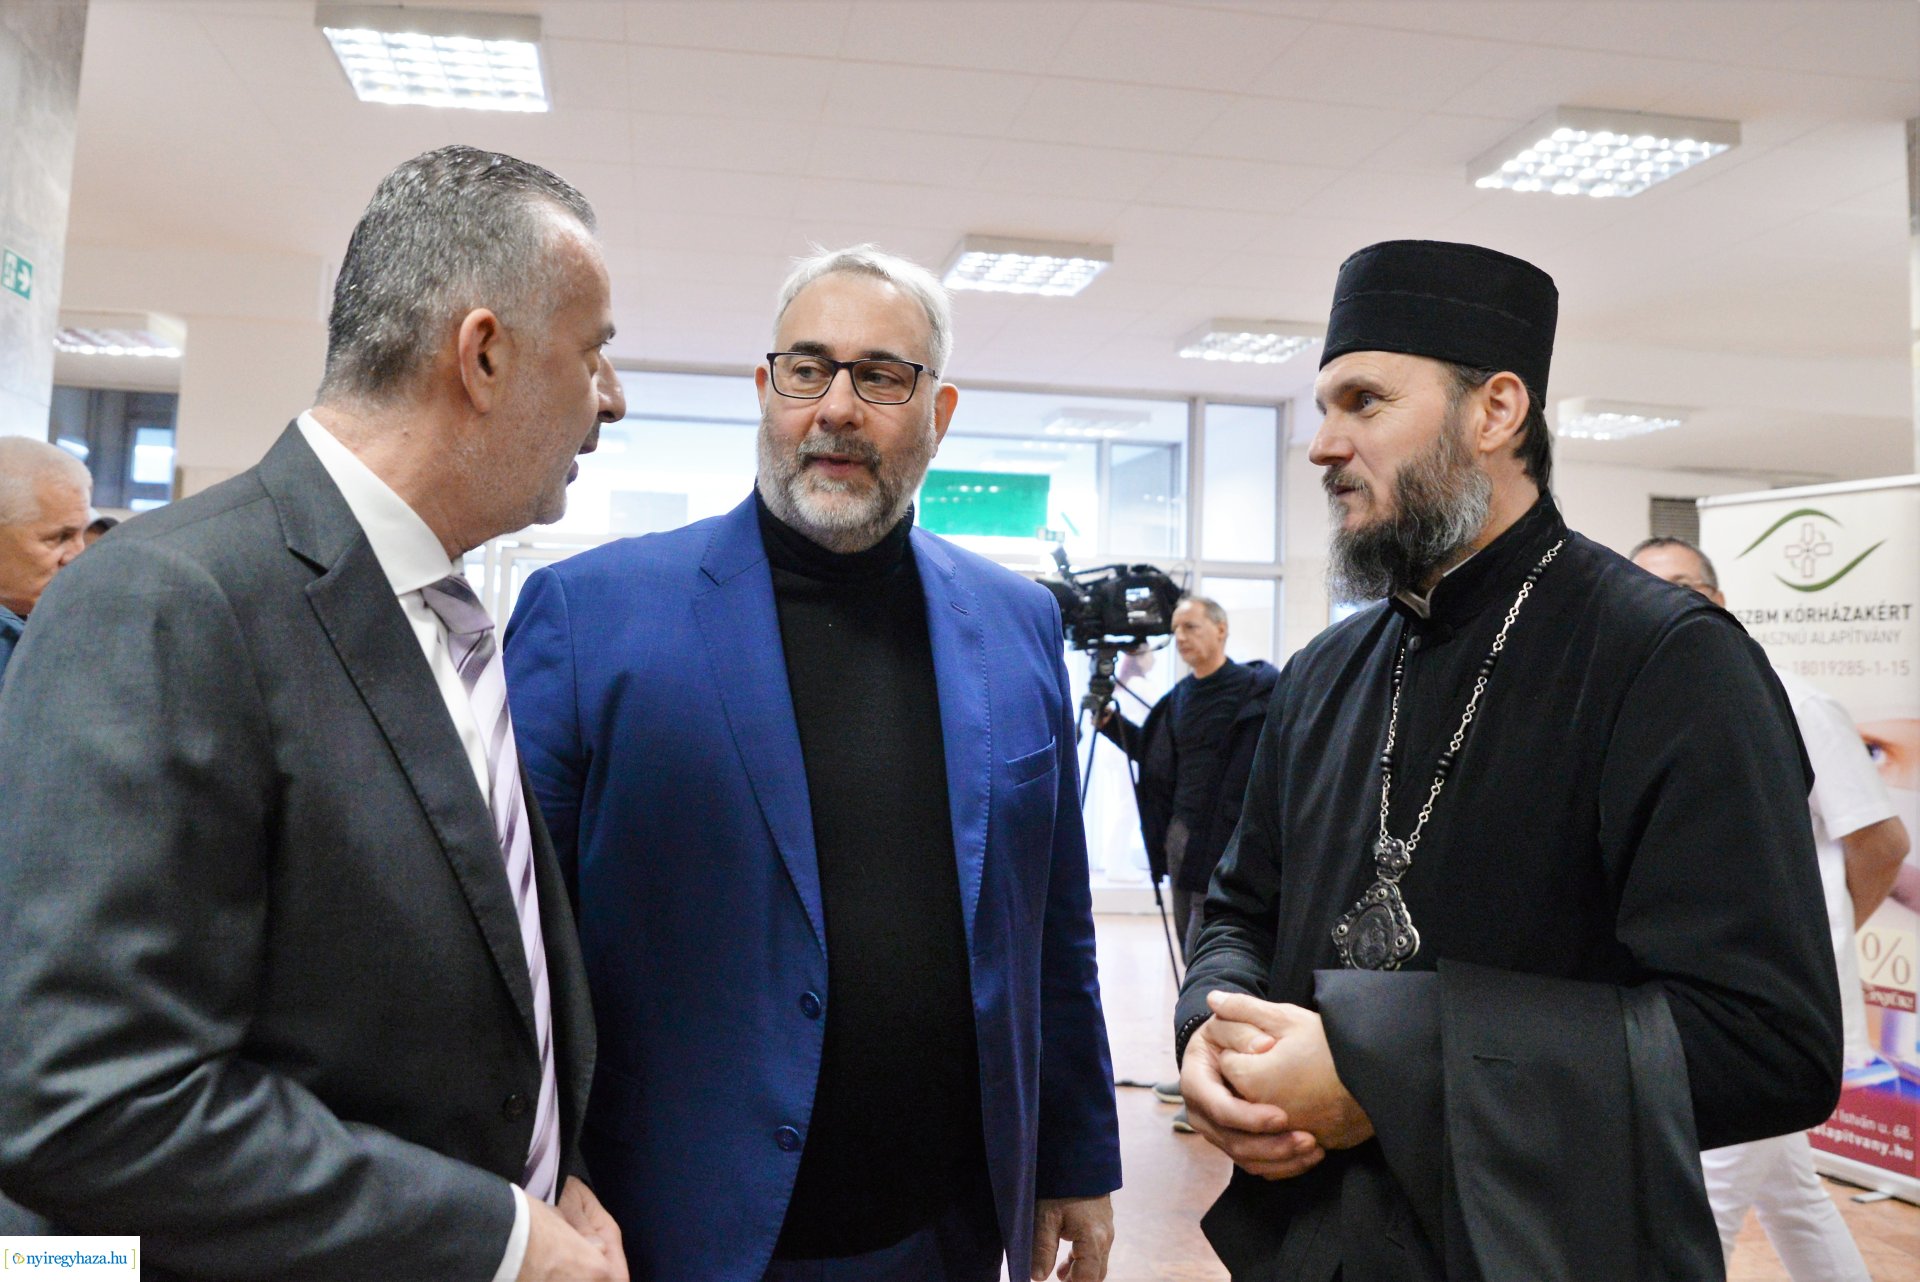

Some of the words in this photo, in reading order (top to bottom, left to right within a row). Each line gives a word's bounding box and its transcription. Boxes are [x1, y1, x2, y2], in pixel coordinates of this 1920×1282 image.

[1731, 608, 1779, 624] SZBM
[1783, 602, 1913, 623] KÓRHÁZAKÉRT
[1754, 628, 1807, 645] ASZNÚ
[1811, 627, 1902, 645] ALAPÍTVÁNY
